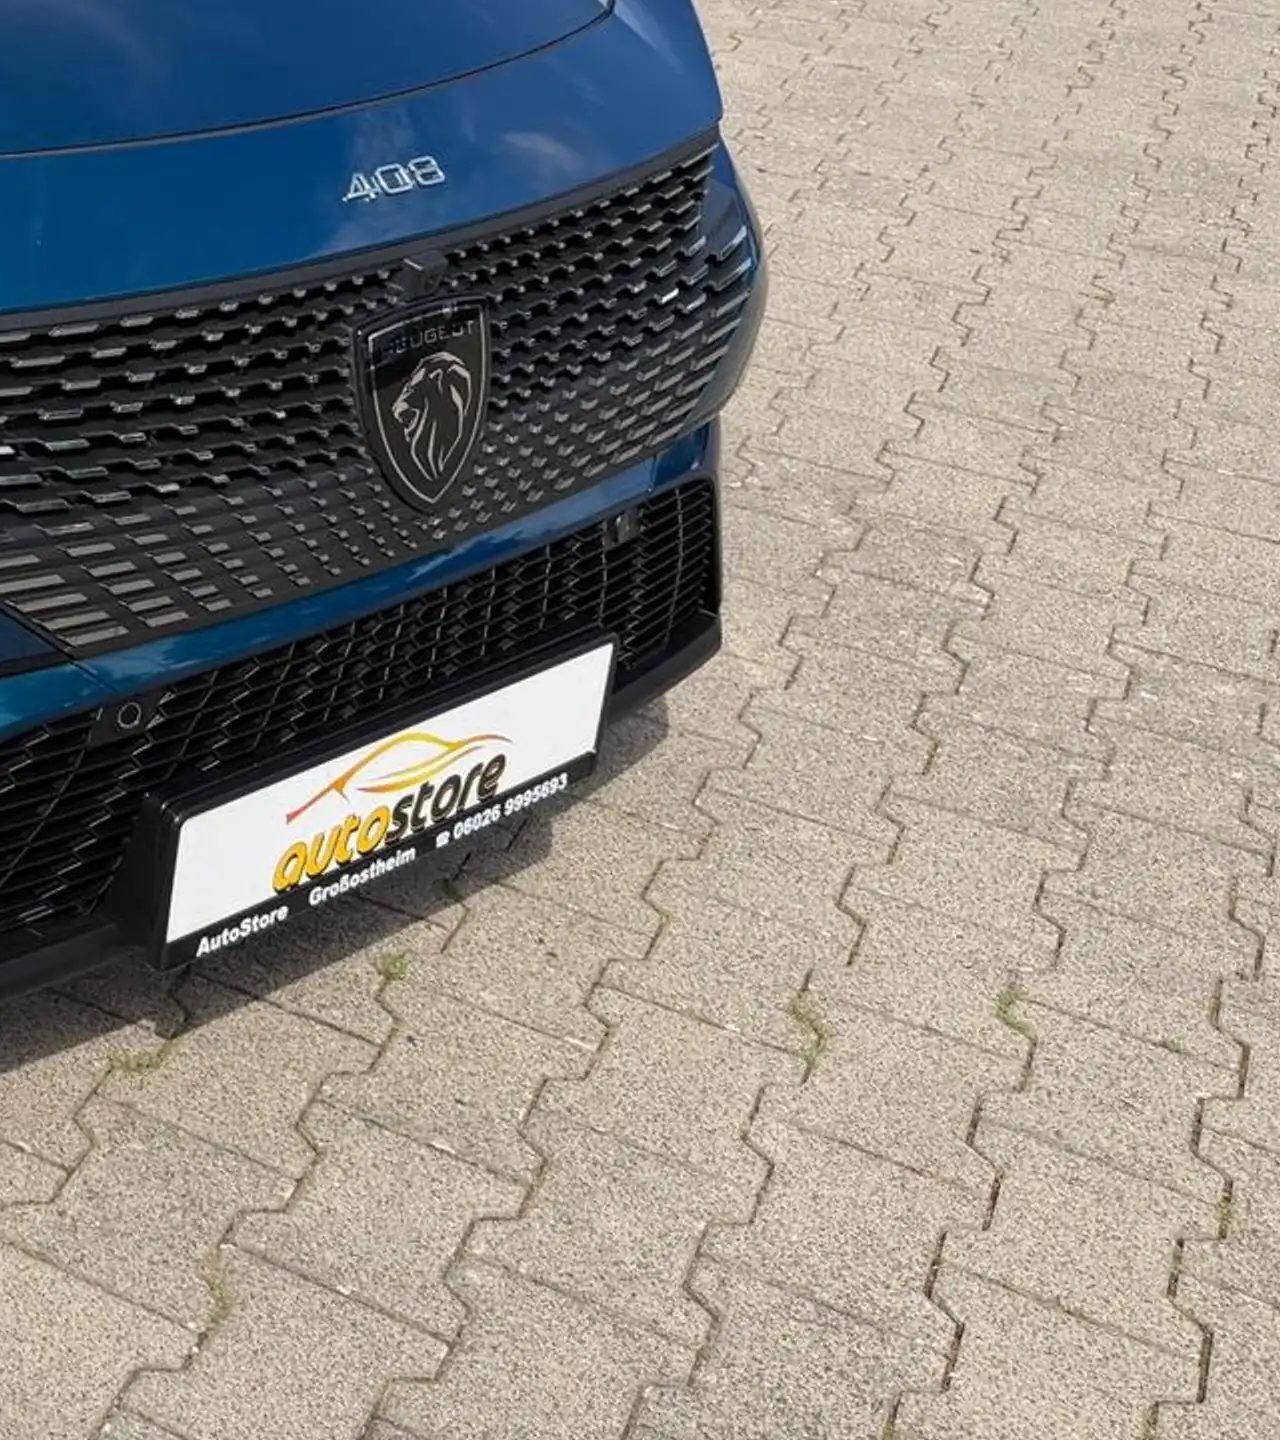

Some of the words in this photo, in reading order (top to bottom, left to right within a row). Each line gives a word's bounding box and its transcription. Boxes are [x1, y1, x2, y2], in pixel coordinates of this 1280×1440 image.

[342, 155, 445, 202] 408
[196, 906, 289, 957] AutoStore
[308, 847, 416, 906] Großostheim
[453, 804, 501, 840] 06026
[272, 754, 507, 893] autostore
